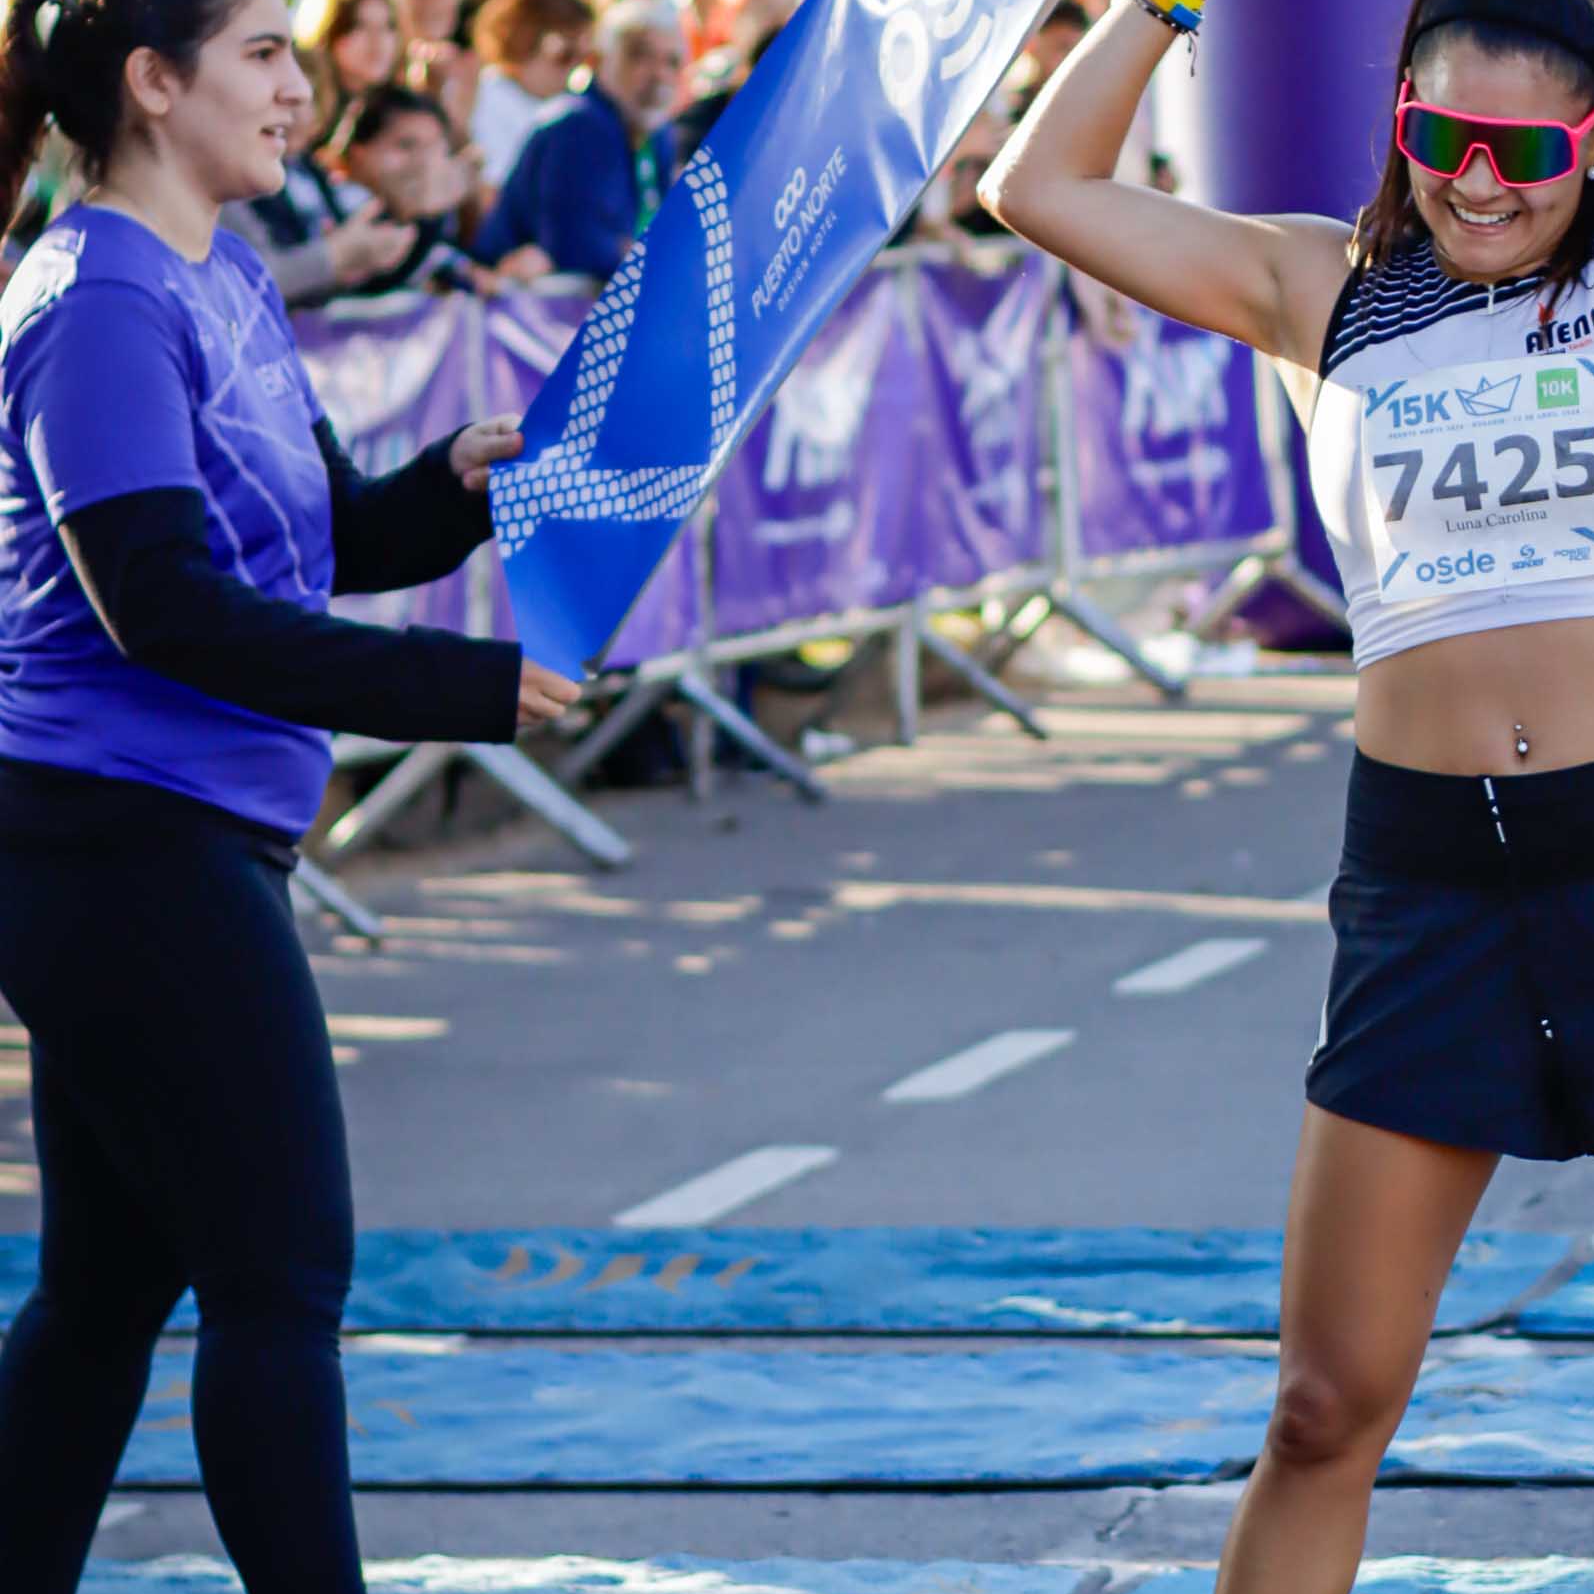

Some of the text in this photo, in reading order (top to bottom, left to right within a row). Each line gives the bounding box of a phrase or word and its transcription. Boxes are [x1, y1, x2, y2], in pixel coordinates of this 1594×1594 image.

[752, 145, 848, 320] PUERTO NORTE
[1539, 379, 1575, 398] 10K
[1387, 389, 1451, 429] 15K
[1445, 508, 1549, 534] Luna Carolina
[1416, 548, 1496, 584] osde
